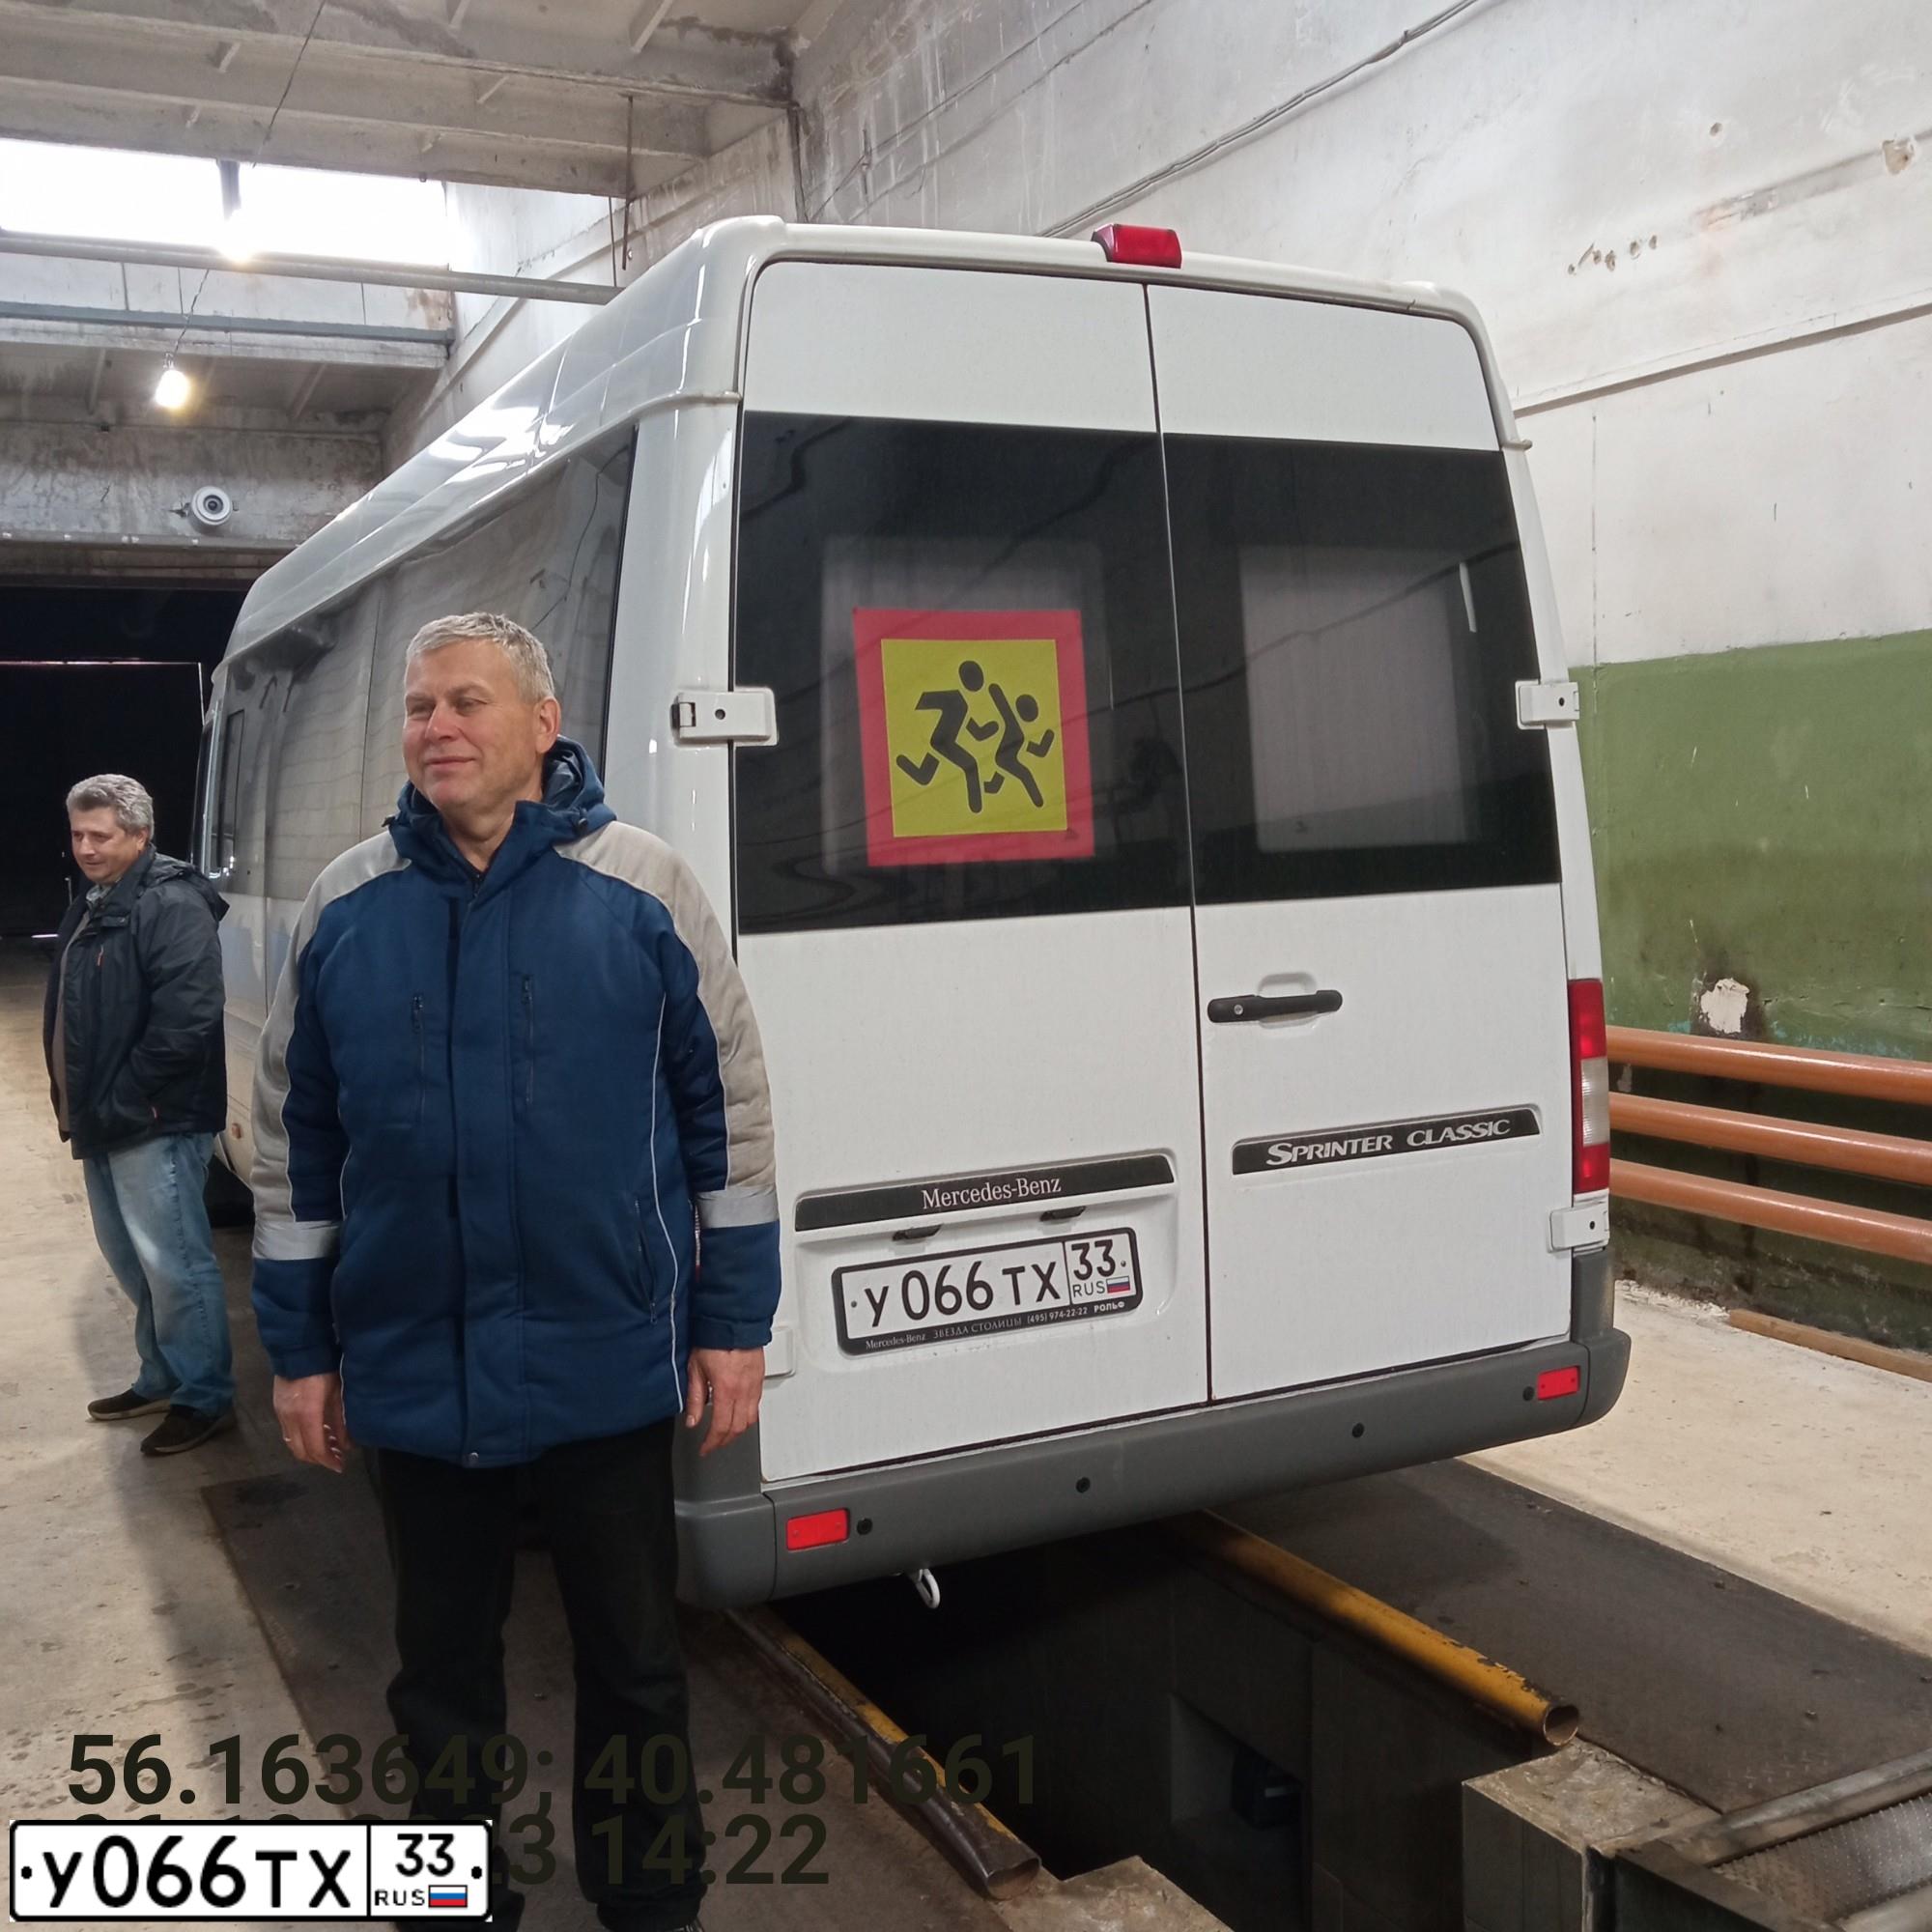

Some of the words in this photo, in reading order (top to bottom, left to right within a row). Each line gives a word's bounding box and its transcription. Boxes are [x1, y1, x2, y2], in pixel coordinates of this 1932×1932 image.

[1265, 1134, 1393, 1166] SPRINTER
[1406, 1119, 1512, 1148] CLASSIC
[921, 1176, 1063, 1209] Mercedes-Benz
[1070, 1238, 1118, 1281] 33
[1072, 1280, 1106, 1296] RUS
[933, 1324, 970, 1340] ЗВЕЗДА
[971, 1317, 1023, 1334] СТОЛИЦЫ
[1094, 1300, 1125, 1314] РОЛЬФ
[866, 1332, 927, 1350] Mercedes-Benz
